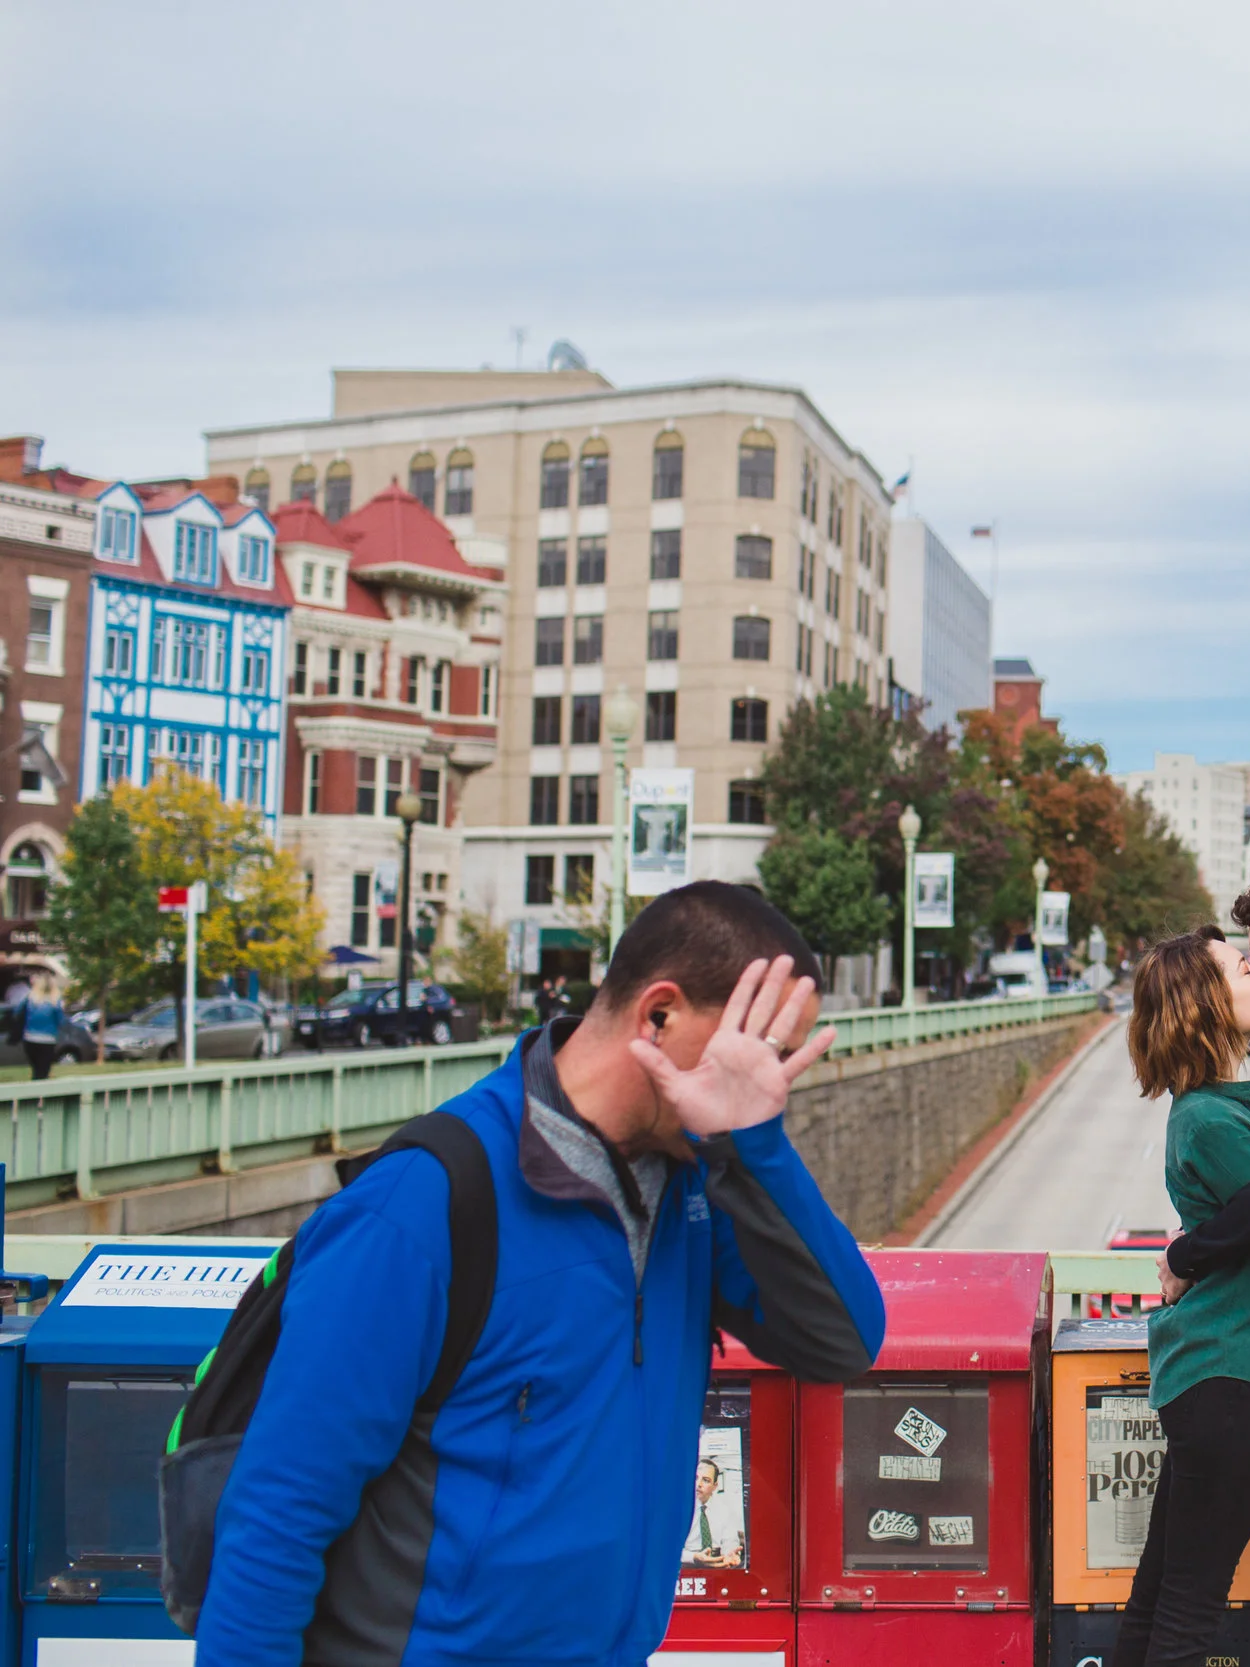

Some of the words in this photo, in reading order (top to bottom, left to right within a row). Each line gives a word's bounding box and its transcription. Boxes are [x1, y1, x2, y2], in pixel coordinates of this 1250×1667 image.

[98, 1264, 176, 1281] THE
[183, 1266, 250, 1283] HIL
[94, 1287, 163, 1297] POLITICS
[191, 1288, 243, 1298] POLICY
[1088, 1419, 1166, 1441] CITYPAPE
[1087, 1460, 1112, 1473] THE
[675, 1578, 706, 1596] REE
